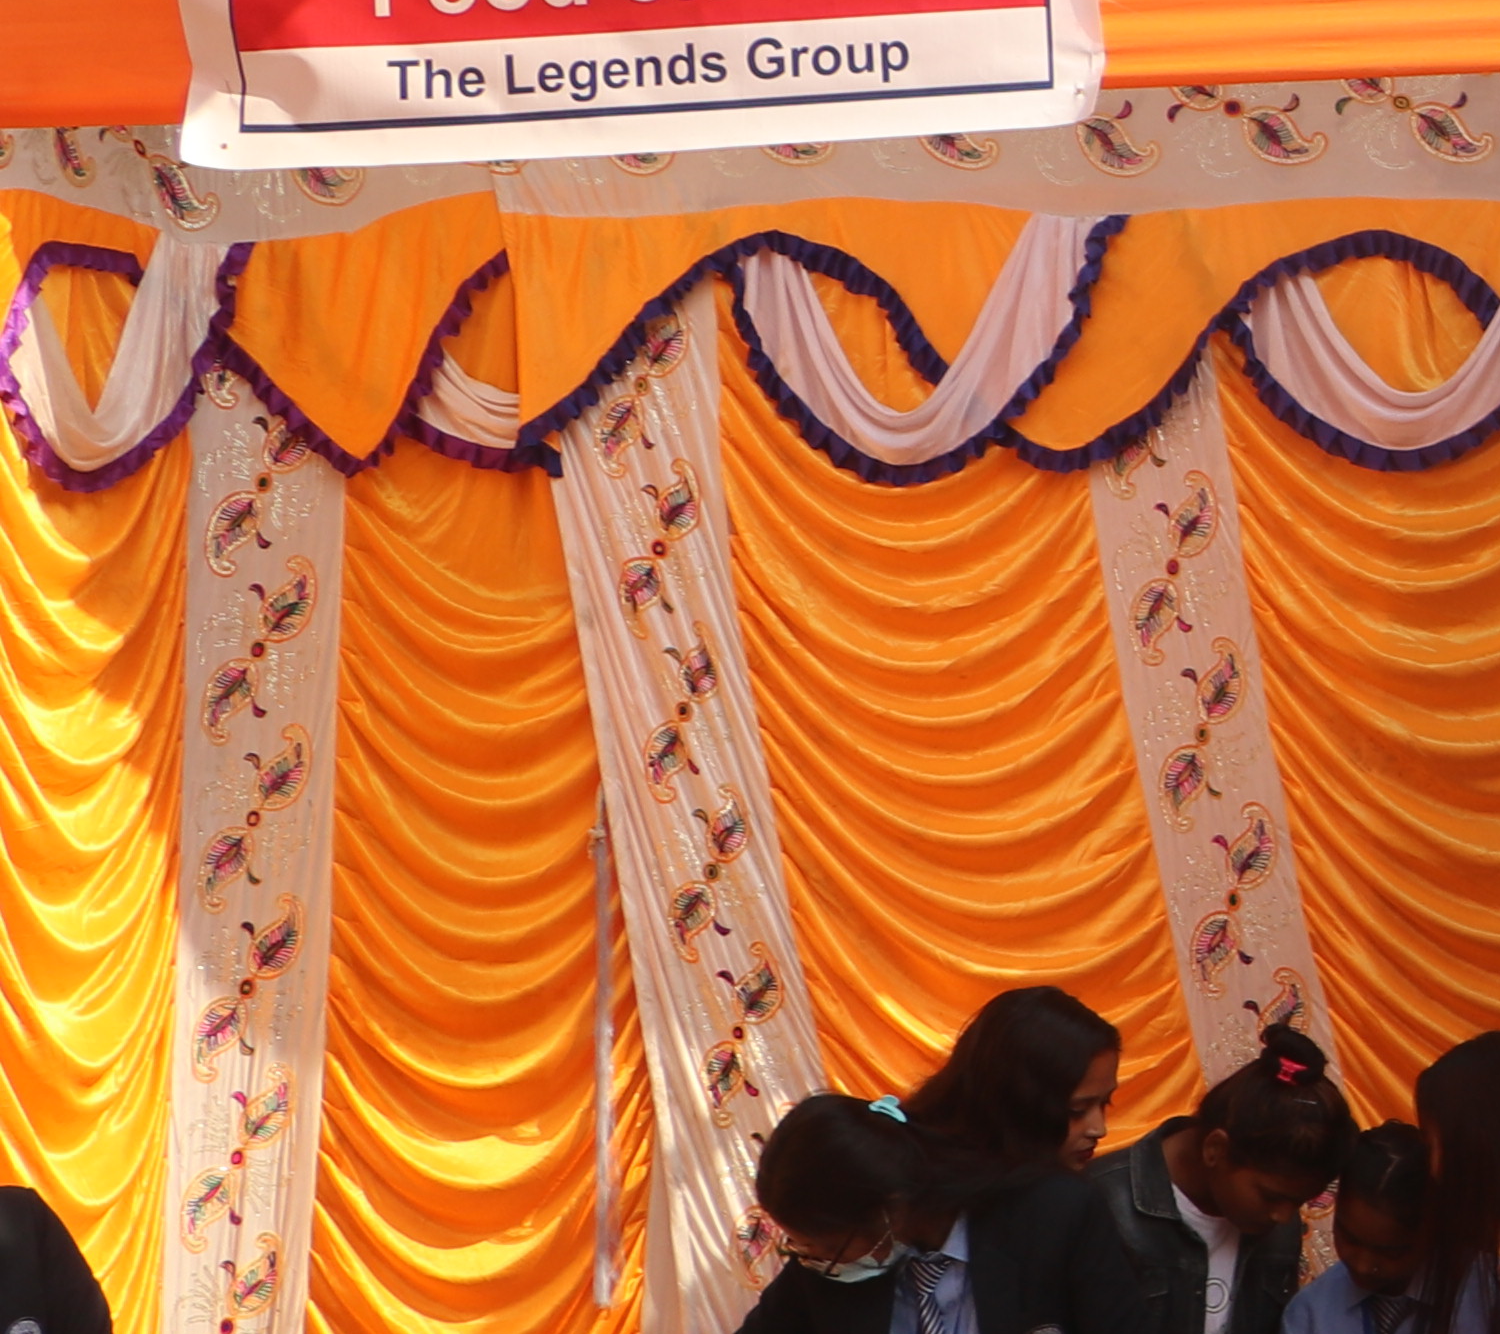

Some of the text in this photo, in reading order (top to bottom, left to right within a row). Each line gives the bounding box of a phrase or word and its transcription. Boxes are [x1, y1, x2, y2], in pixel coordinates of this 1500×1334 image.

[388, 38, 909, 101] The Legends Group
